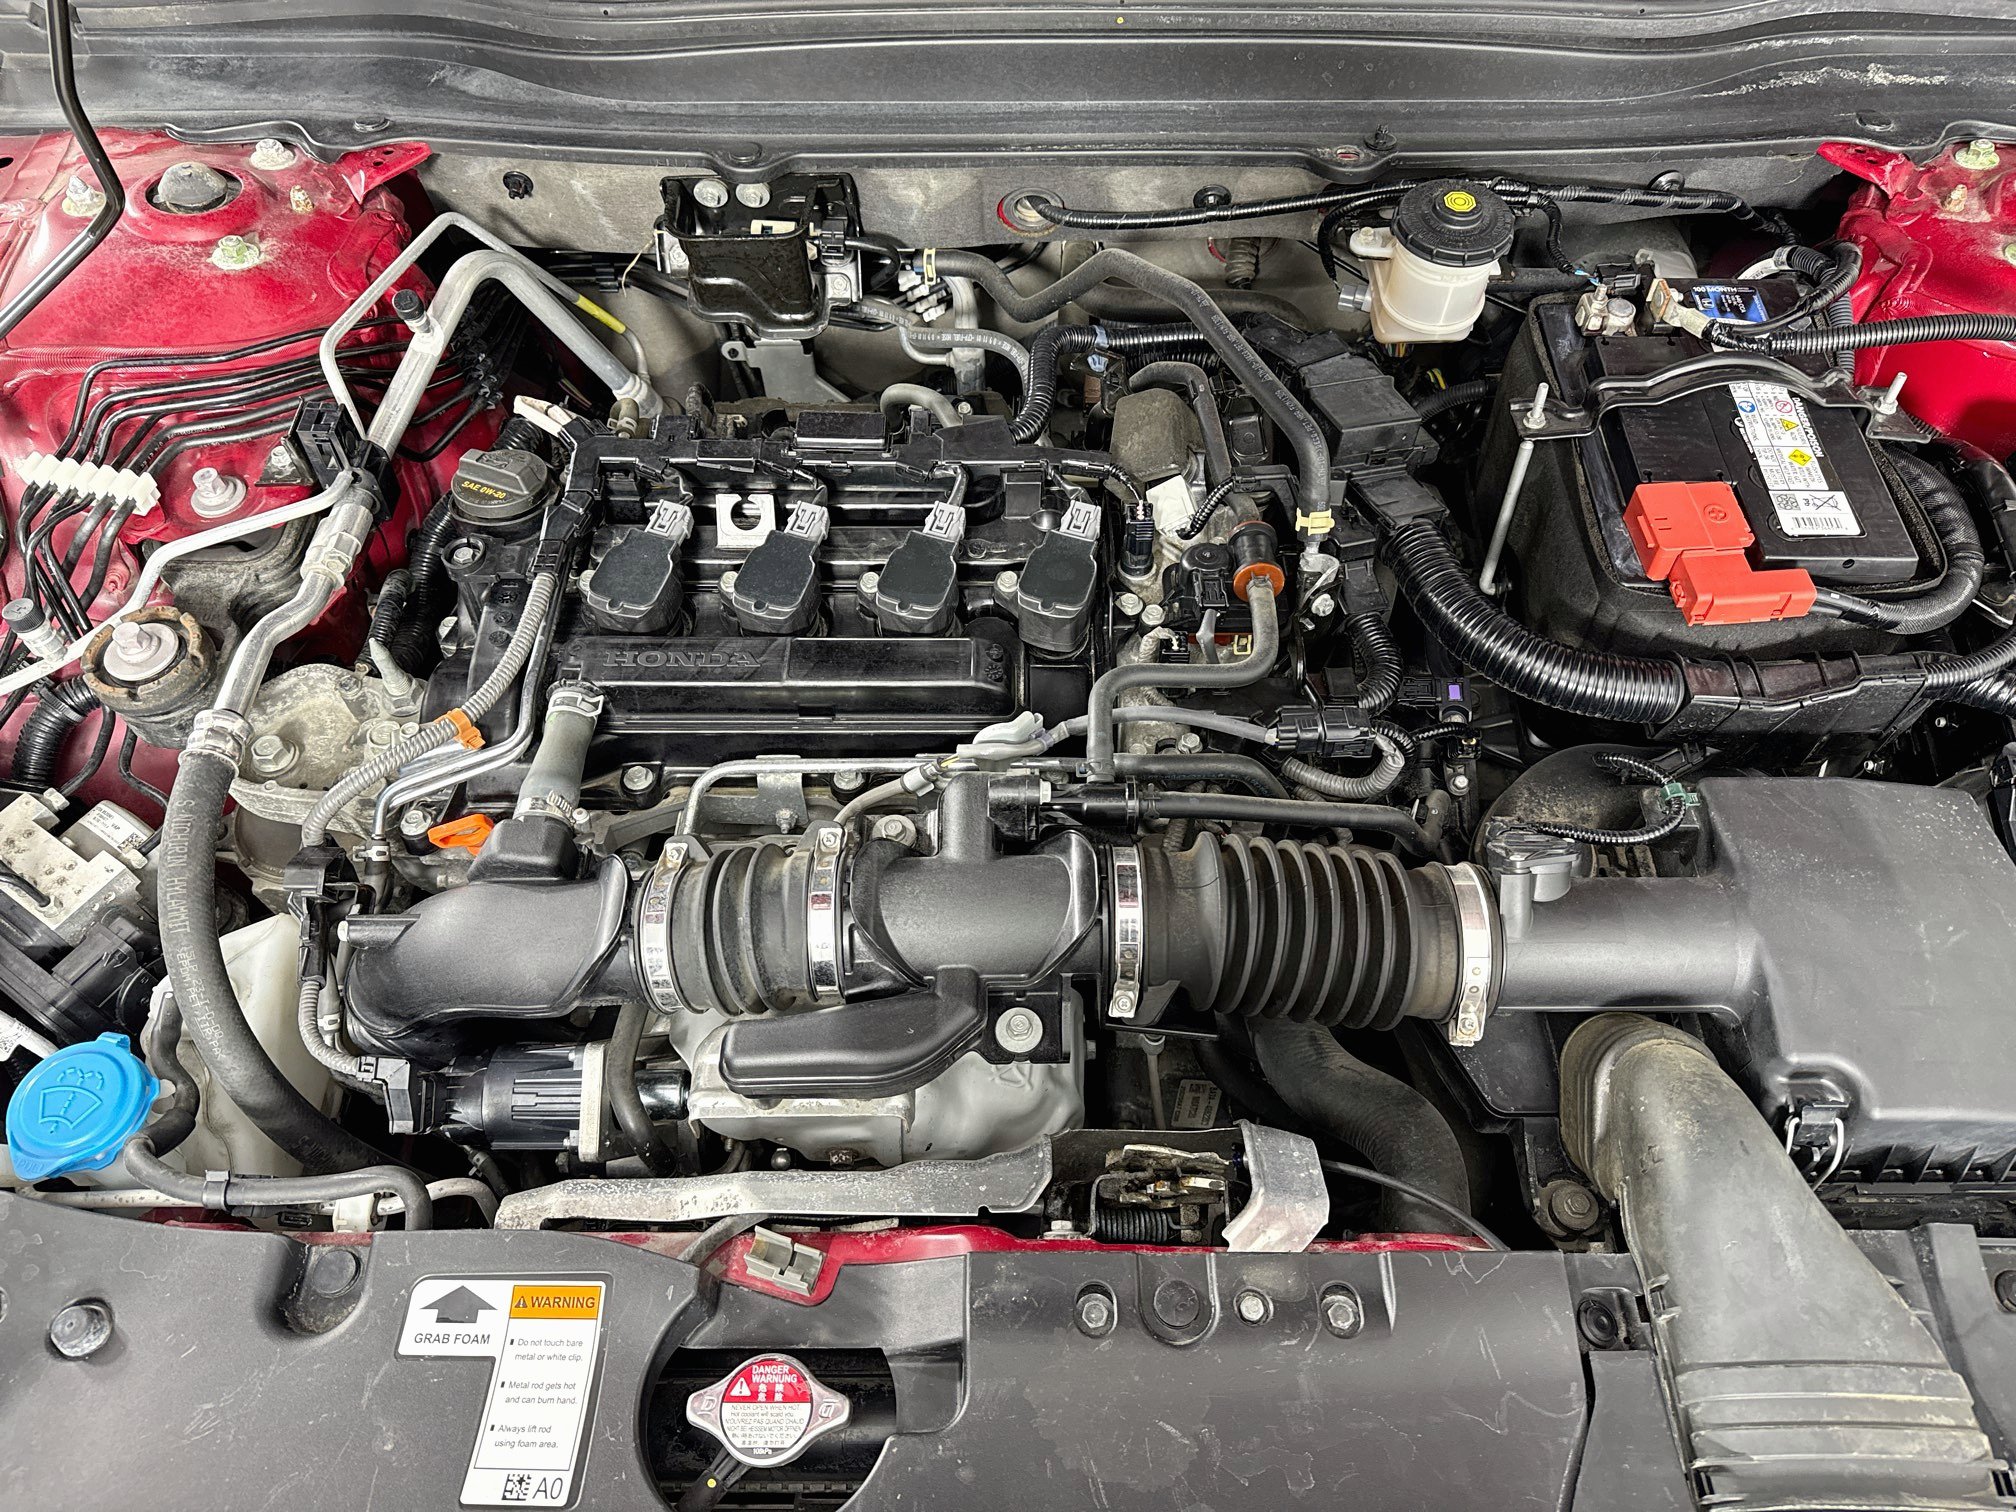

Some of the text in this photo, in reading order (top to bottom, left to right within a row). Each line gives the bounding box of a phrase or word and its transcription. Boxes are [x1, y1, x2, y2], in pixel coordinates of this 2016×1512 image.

[1792, 397, 1824, 458] DANGER/POISON
[462, 481, 506, 498] SAE 0W-20
[603, 650, 761, 668] HONDA
[166, 814, 194, 868] NICHIRIN
[530, 1296, 596, 1309] WARNING
[414, 1333, 490, 1344] GRAB FOAM
[517, 1338, 584, 1347] Do not touch bare
[568, 1354, 584, 1362] clip.
[752, 1365, 789, 1374] DANGER
[752, 1374, 798, 1383] WARNUNG
[545, 1382, 562, 1392] gets
[564, 1382, 576, 1390] hot
[556, 1396, 578, 1404] hand.
[498, 1425, 526, 1434] Always
[528, 1425, 537, 1433] lift
[494, 1439, 559, 1449] using foam area.
[532, 1477, 564, 1500] A0
